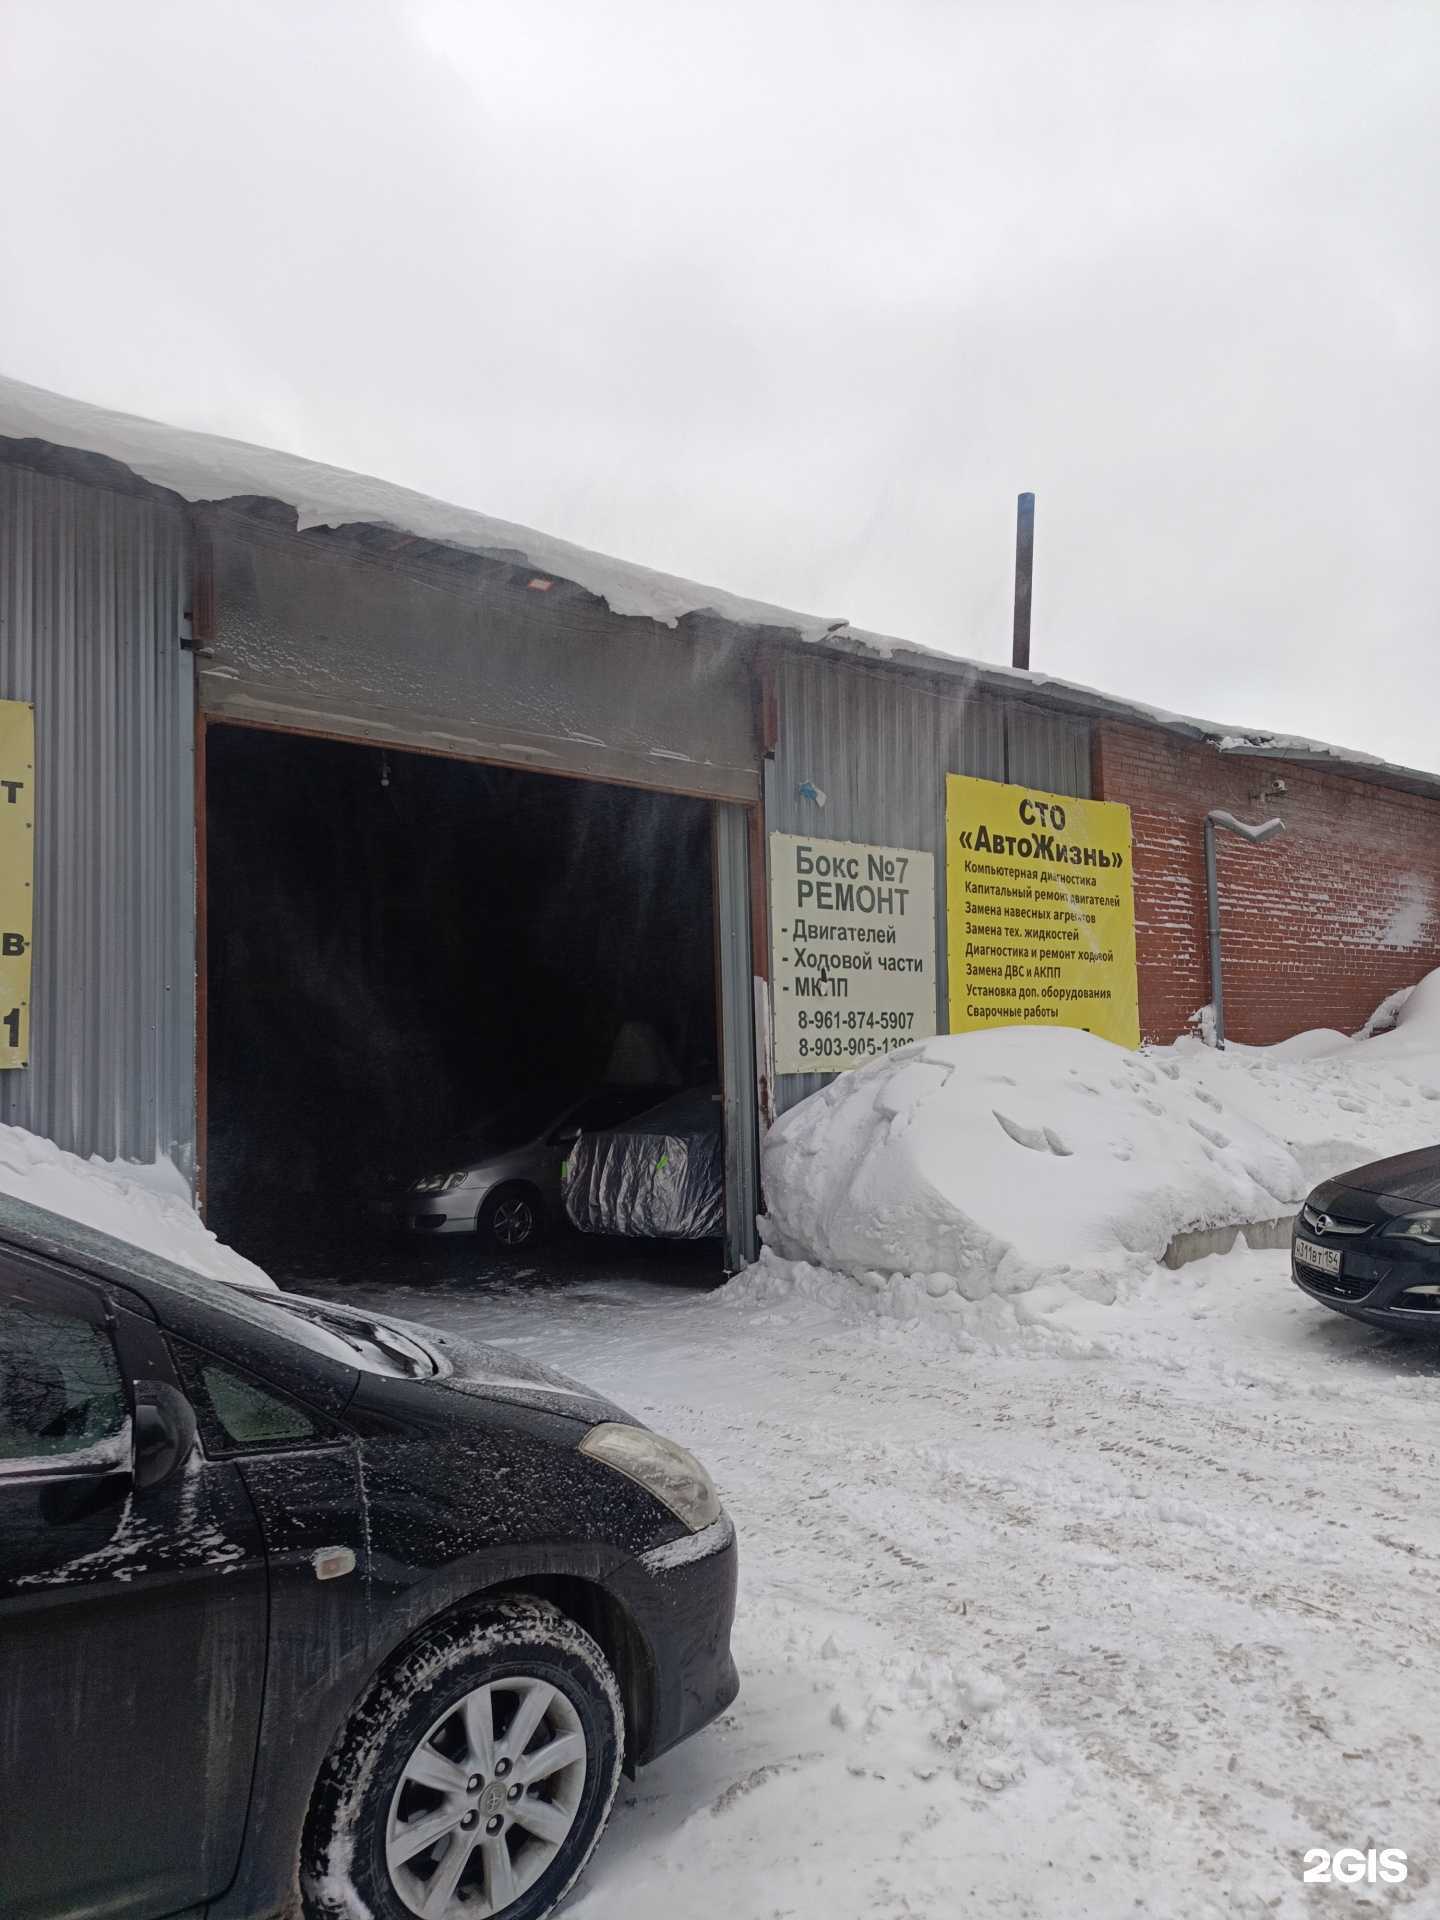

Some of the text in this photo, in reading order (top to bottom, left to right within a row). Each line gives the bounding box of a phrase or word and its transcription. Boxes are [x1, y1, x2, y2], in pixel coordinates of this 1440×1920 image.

[1019, 799, 1066, 831] СТО
[959, 825, 1123, 868] «АвтоЖизнь»
[796, 845, 909, 884] Бокс №7
[965, 861, 1038, 881] Компьютерная
[797, 879, 910, 916] РЕМОНТ
[965, 881, 1032, 898] Капитальный
[965, 901, 1001, 916] Замена
[1004, 906, 1051, 920] навесных
[792, 919, 896, 944] Двигателей
[966, 922, 1079, 941] Замена тех. жидкостей
[794, 947, 873, 972] Ходовой
[878, 956, 923, 972] части
[966, 943, 1113, 962] Диагностика и ремонт ходовой
[966, 963, 1061, 980] Замена ДВС и АКПП
[966, 984, 1112, 1000] Установка доп. оборудования
[798, 1010, 914, 1029] 8-961-874-5907
[967, 1004, 1059, 1020] Сварочные работы
